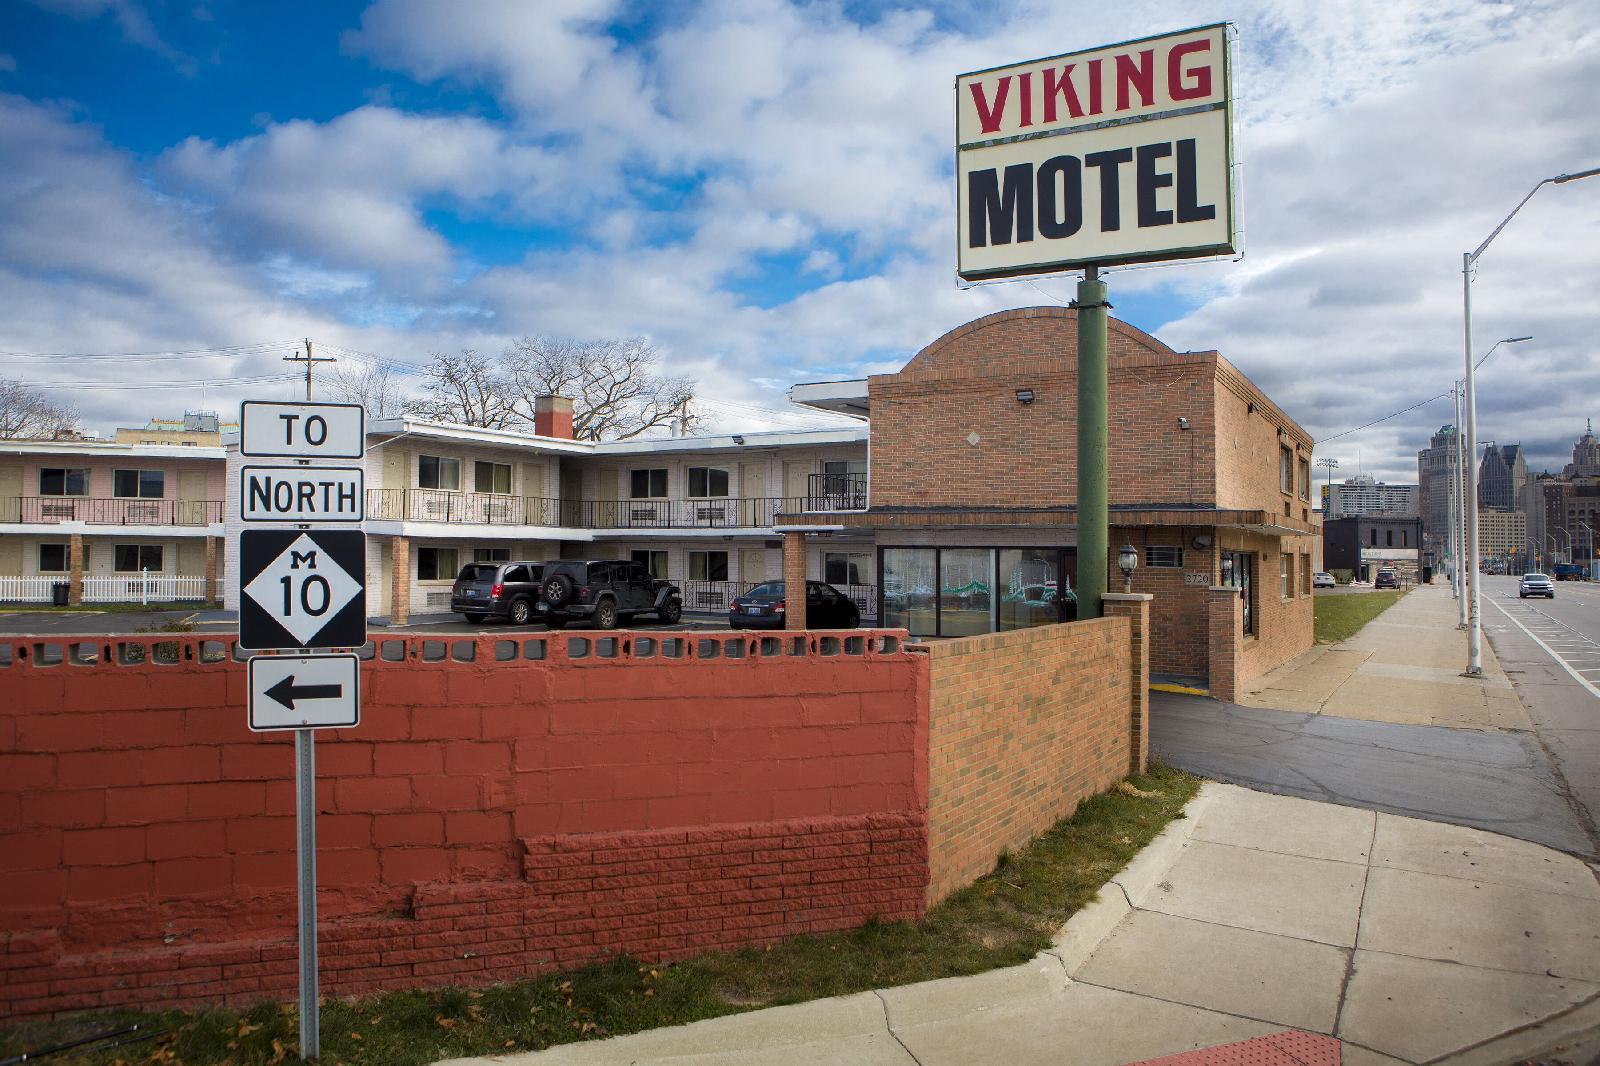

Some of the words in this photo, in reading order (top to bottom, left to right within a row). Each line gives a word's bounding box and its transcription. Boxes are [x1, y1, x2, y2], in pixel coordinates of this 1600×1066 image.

[969, 38, 1212, 134] VIKING
[968, 138, 1216, 248] MOTEL
[279, 414, 328, 447] TO
[249, 475, 356, 514] NORTH
[290, 550, 317, 570] M
[280, 574, 331, 617] 10
